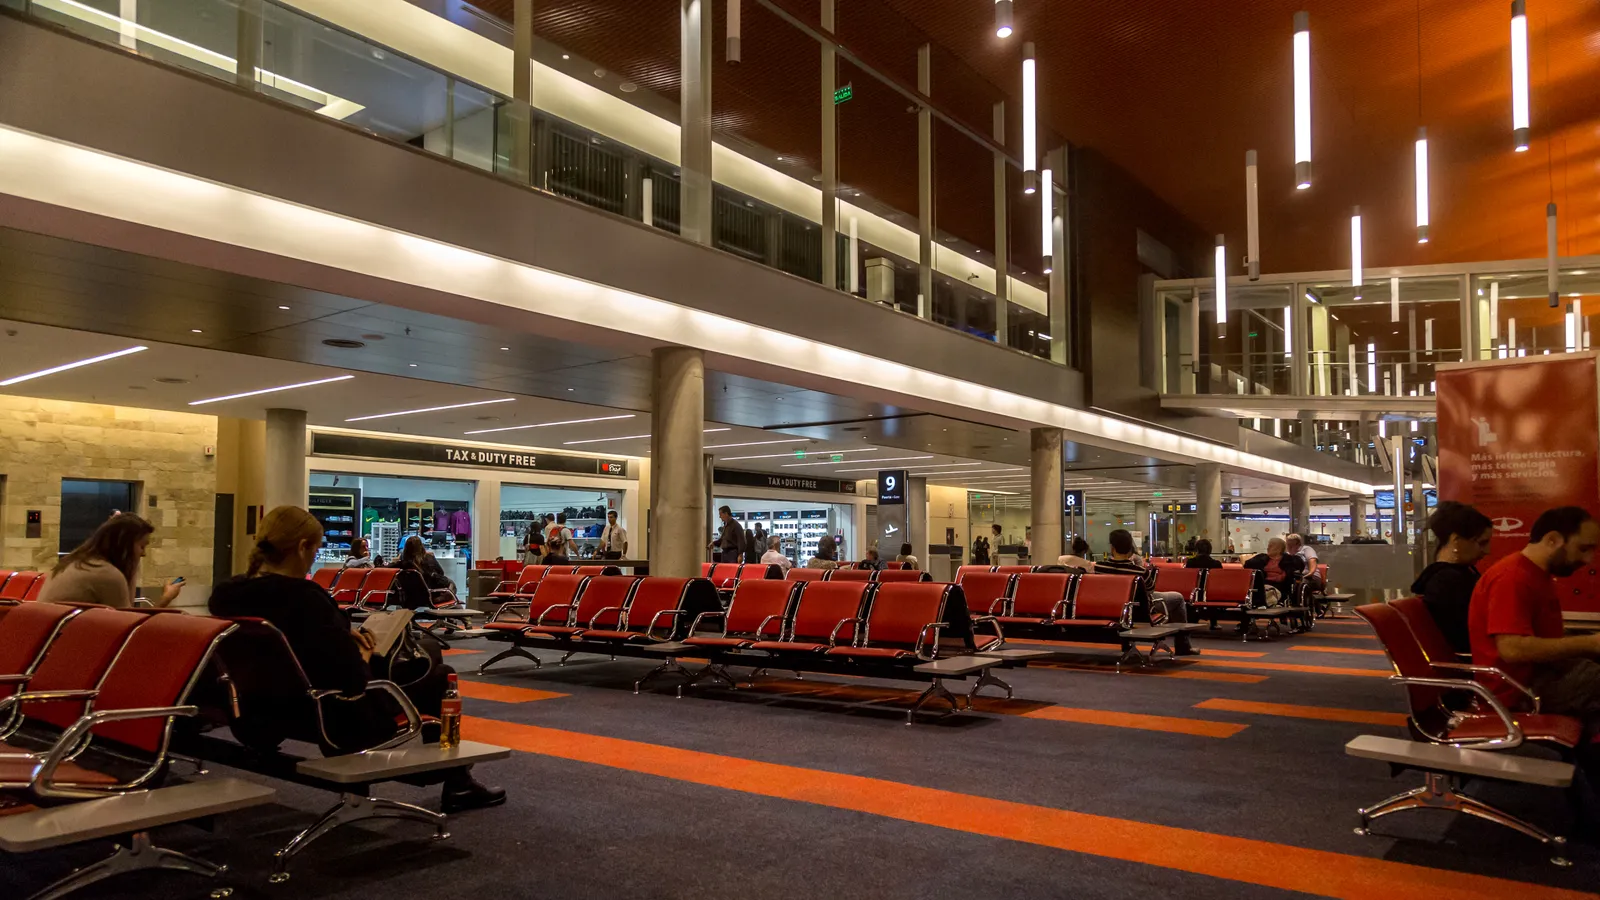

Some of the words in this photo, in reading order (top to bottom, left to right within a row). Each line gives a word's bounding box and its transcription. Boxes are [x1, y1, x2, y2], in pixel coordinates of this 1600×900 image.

[446, 449, 469, 461] TAX
[470, 452, 477, 460] &
[478, 452, 508, 464] DUTY
[509, 454, 536, 467] FREE
[1471, 453, 1493, 461] Más
[1471, 462, 1493, 470] más
[1496, 459, 1556, 470] tecnología
[1471, 473, 1478, 481] y
[1480, 471, 1502, 479] más
[768, 477, 780, 486] TAX
[785, 479, 801, 488] DUTY
[801, 480, 817, 489] FREE
[885, 476, 896, 491] 9
[1066, 494, 1075, 506] 8
